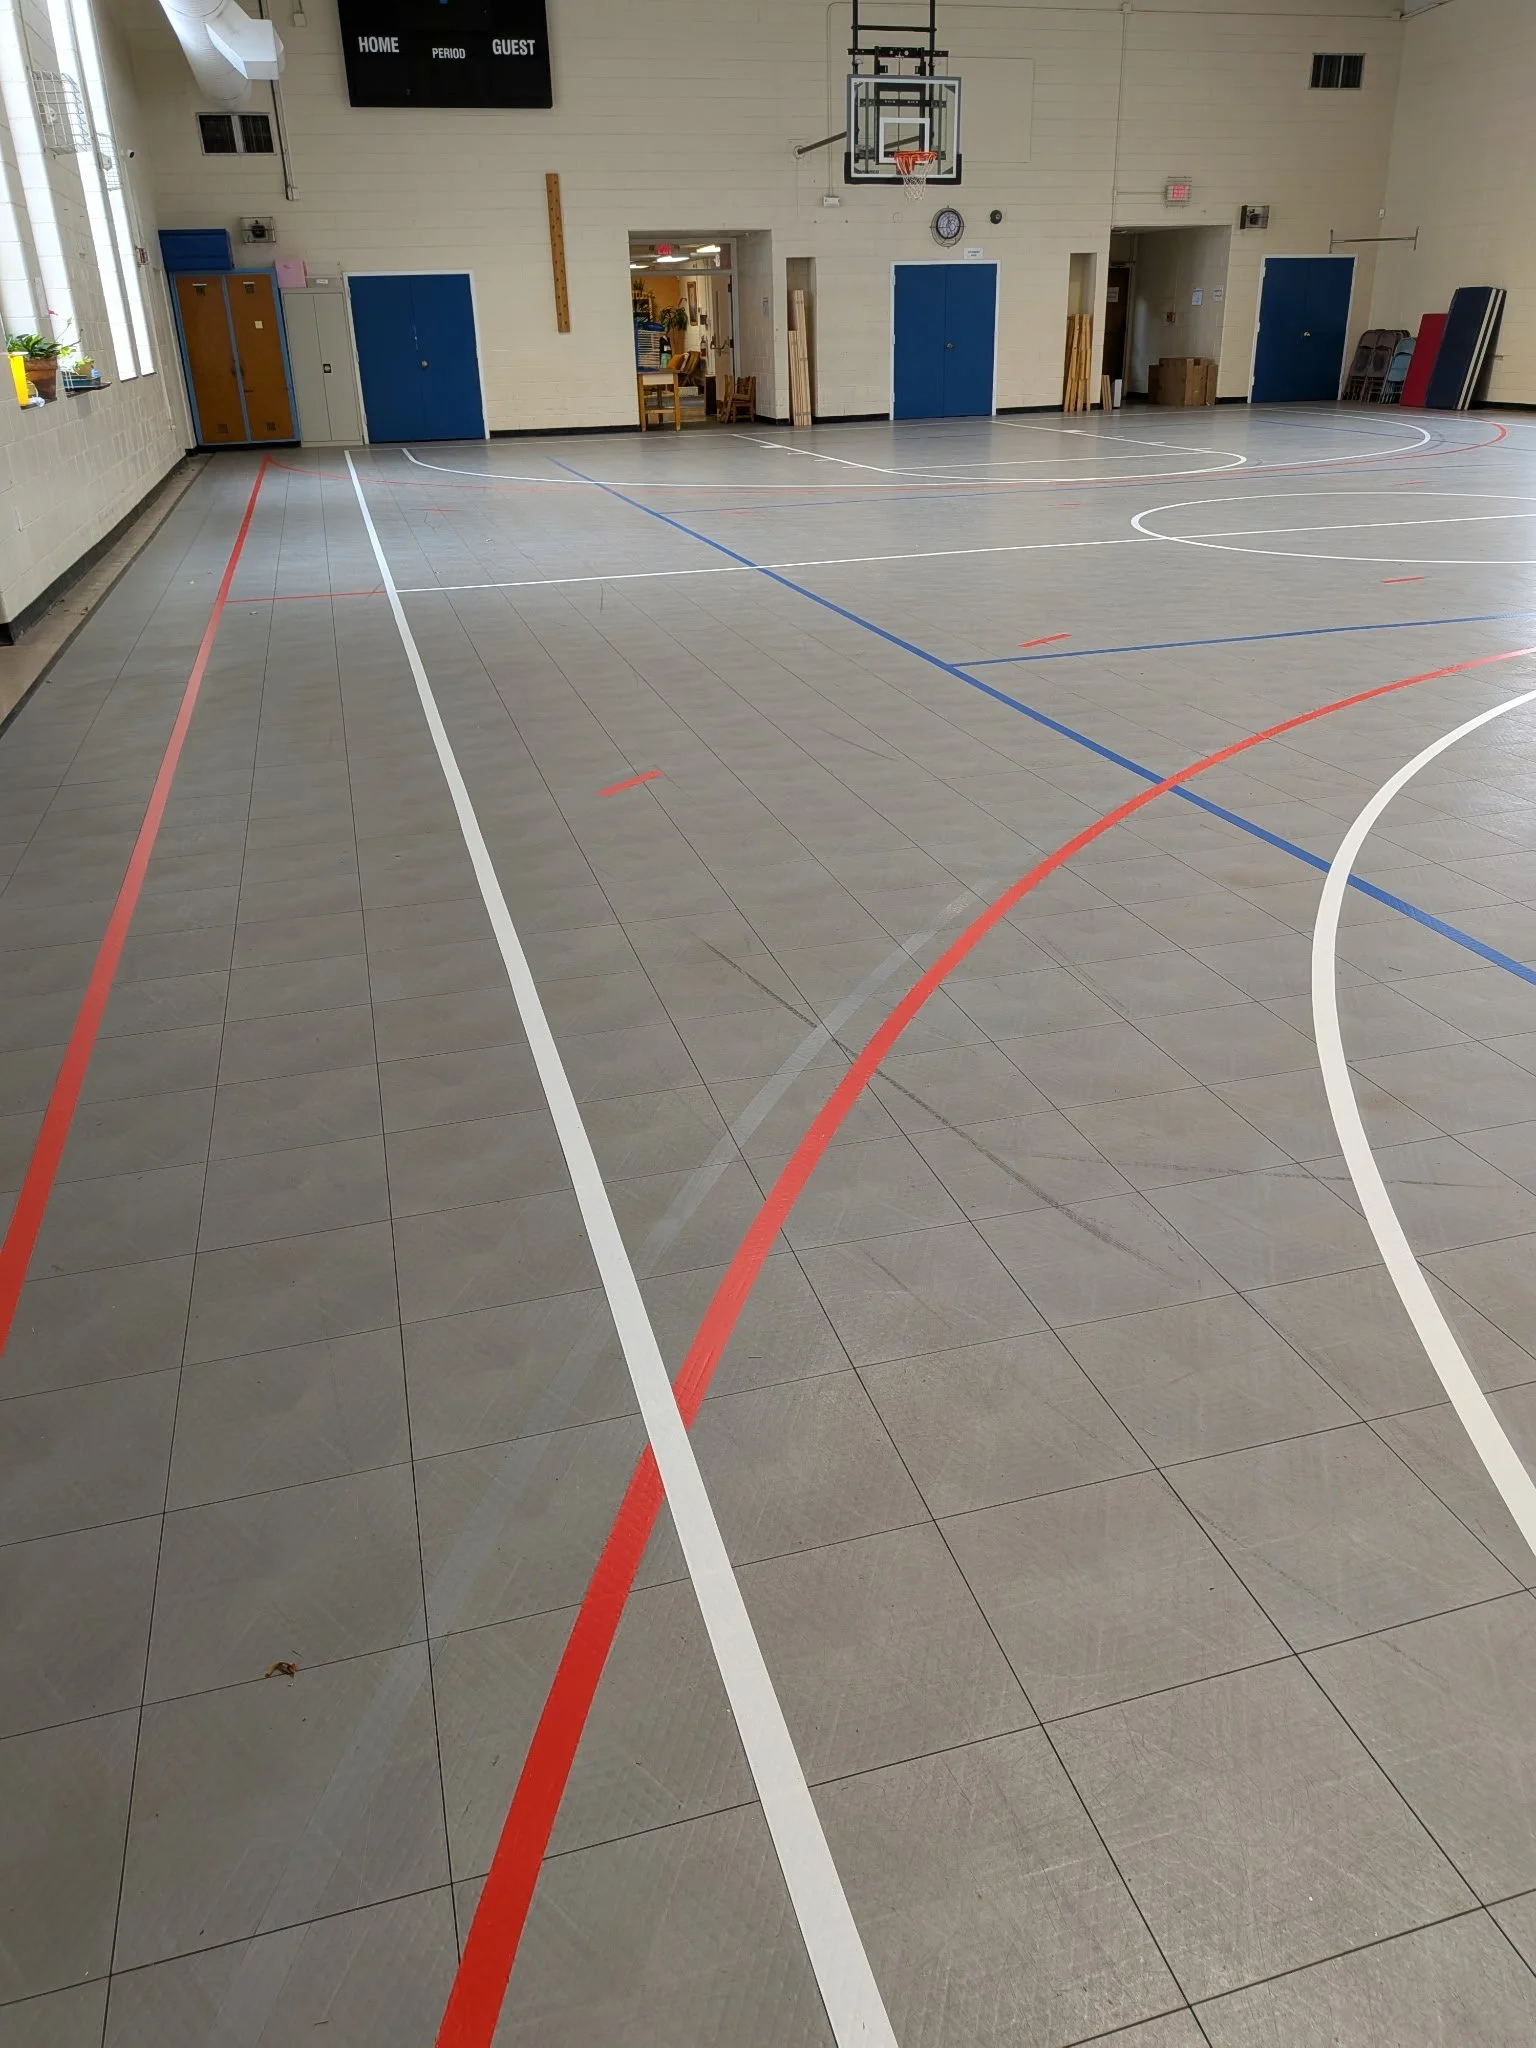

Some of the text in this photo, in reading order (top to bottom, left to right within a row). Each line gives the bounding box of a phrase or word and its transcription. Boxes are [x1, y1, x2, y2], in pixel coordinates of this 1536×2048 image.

[358, 36, 400, 53] HOME
[432, 47, 466, 59] PERIOD
[492, 39, 536, 56] GUEST
